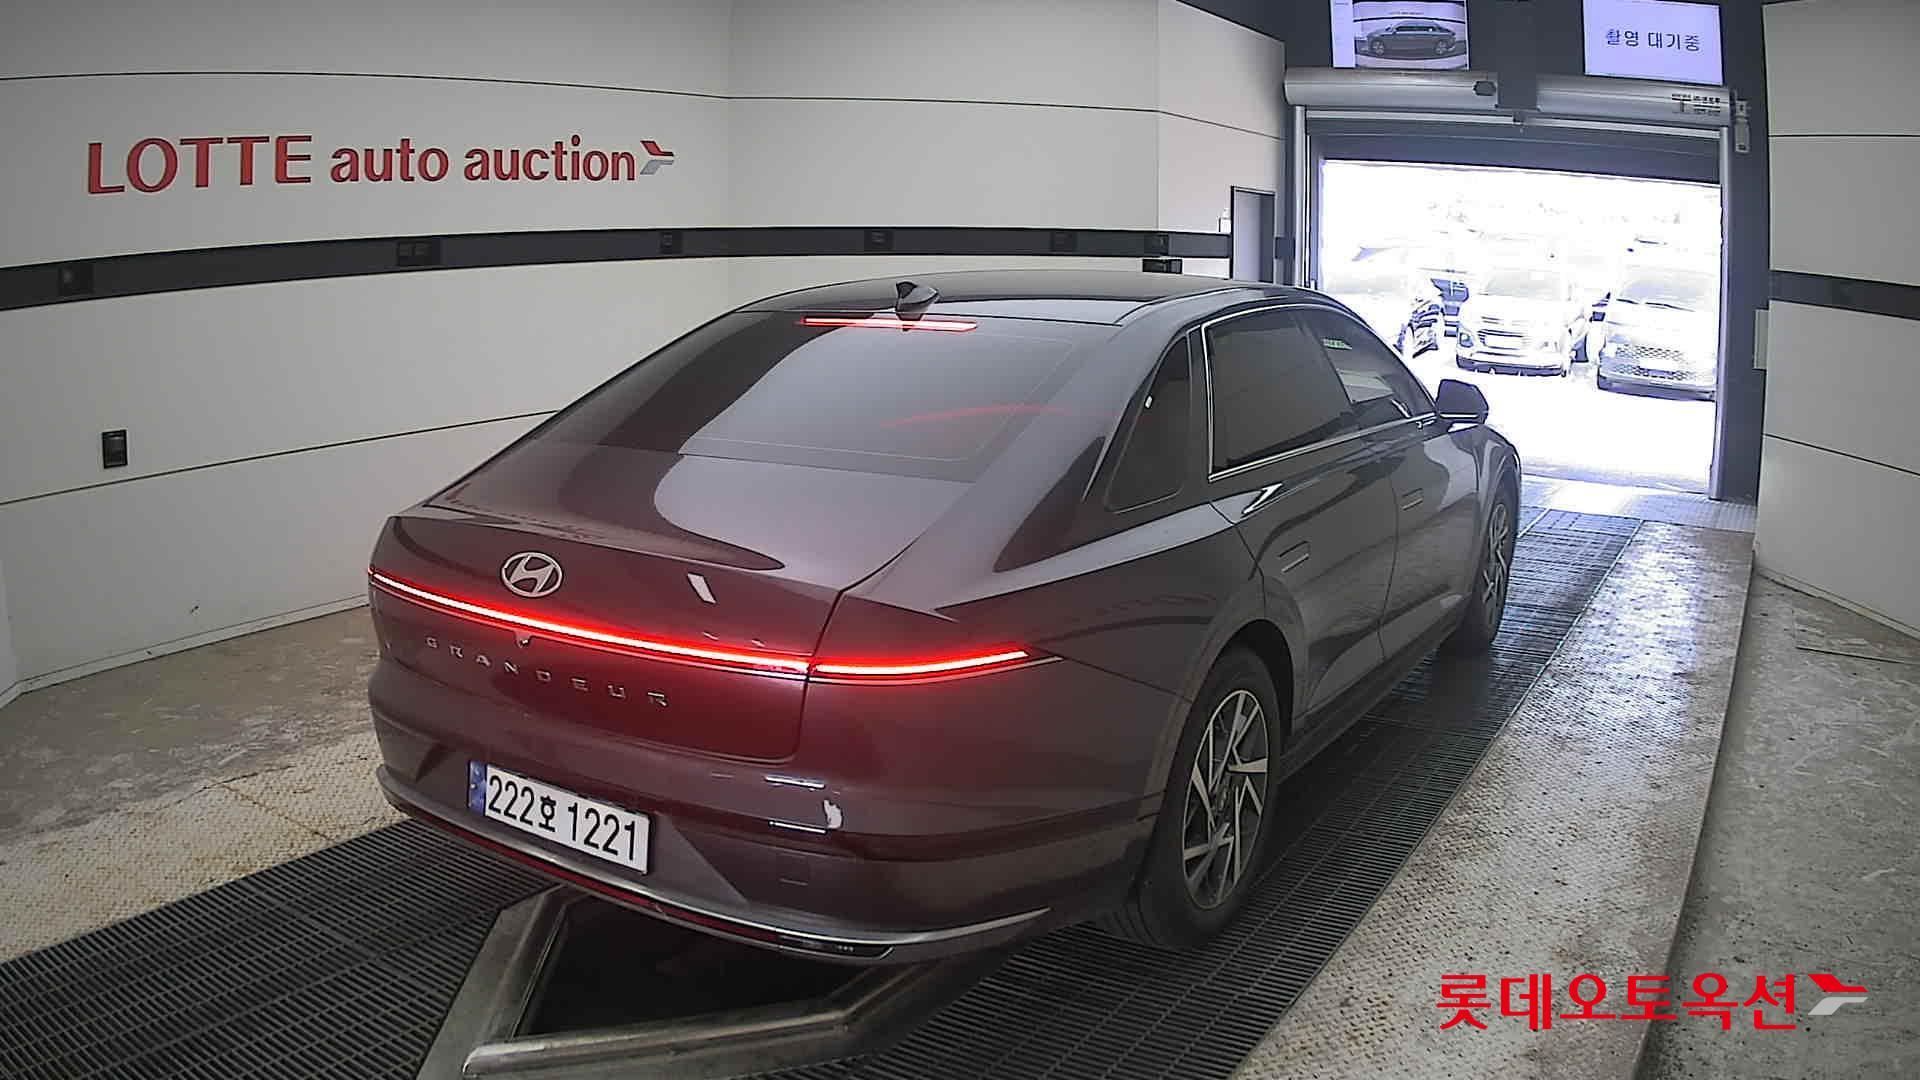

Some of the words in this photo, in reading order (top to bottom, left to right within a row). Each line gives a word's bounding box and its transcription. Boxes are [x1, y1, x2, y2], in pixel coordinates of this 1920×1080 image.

[1647, 31, 1701, 52] 대기중
[88, 135, 312, 194] LOTTE
[329, 138, 450, 183] auto
[463, 134, 636, 182] auction
[425, 636, 668, 707] GRANDEUR
[488, 775, 557, 833] 222호
[567, 802, 636, 861] 1221
